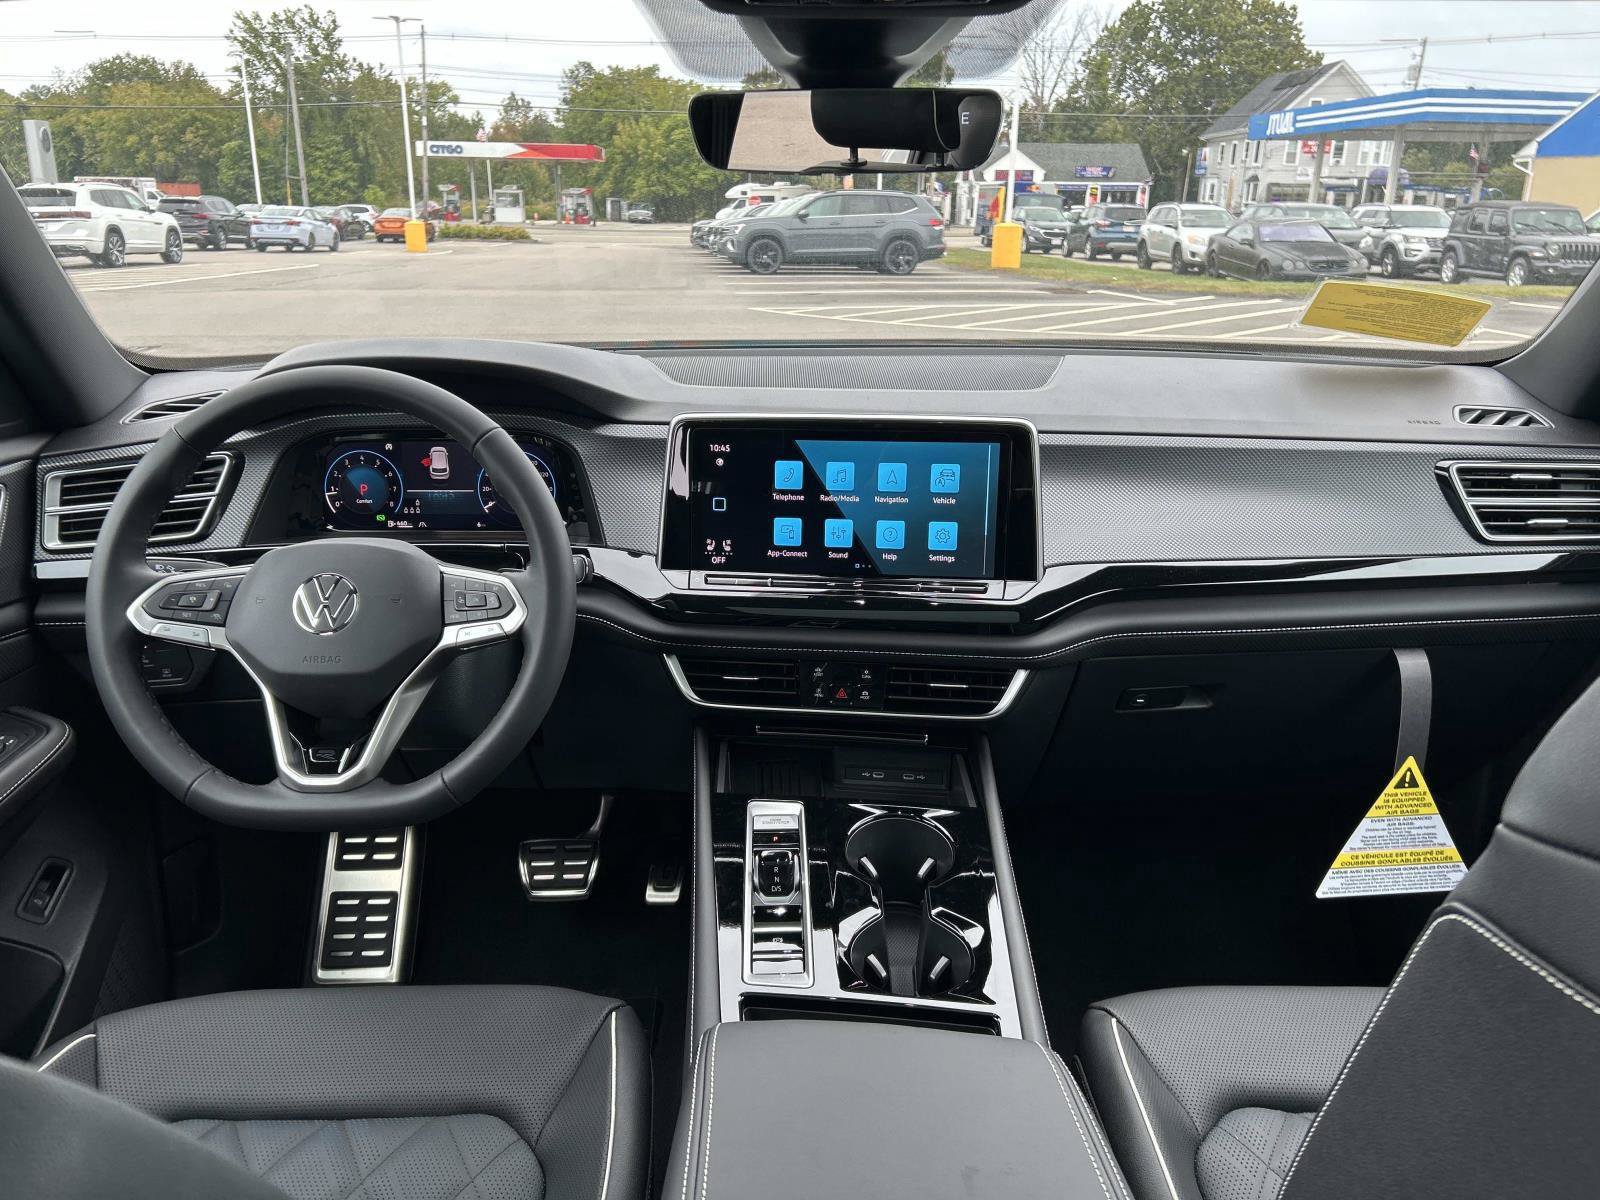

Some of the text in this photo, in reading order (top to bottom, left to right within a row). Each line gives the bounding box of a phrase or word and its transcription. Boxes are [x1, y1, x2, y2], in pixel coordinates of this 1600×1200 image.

[962, 112, 970, 124] E
[430, 144, 463, 154] CITGO
[360, 484, 368, 496] P
[874, 496, 908, 504] Navigation
[767, 550, 807, 558] App-Connect
[882, 553, 897, 561] Help
[928, 554, 955, 562] Settings
[302, 656, 341, 664] AIRBAG
